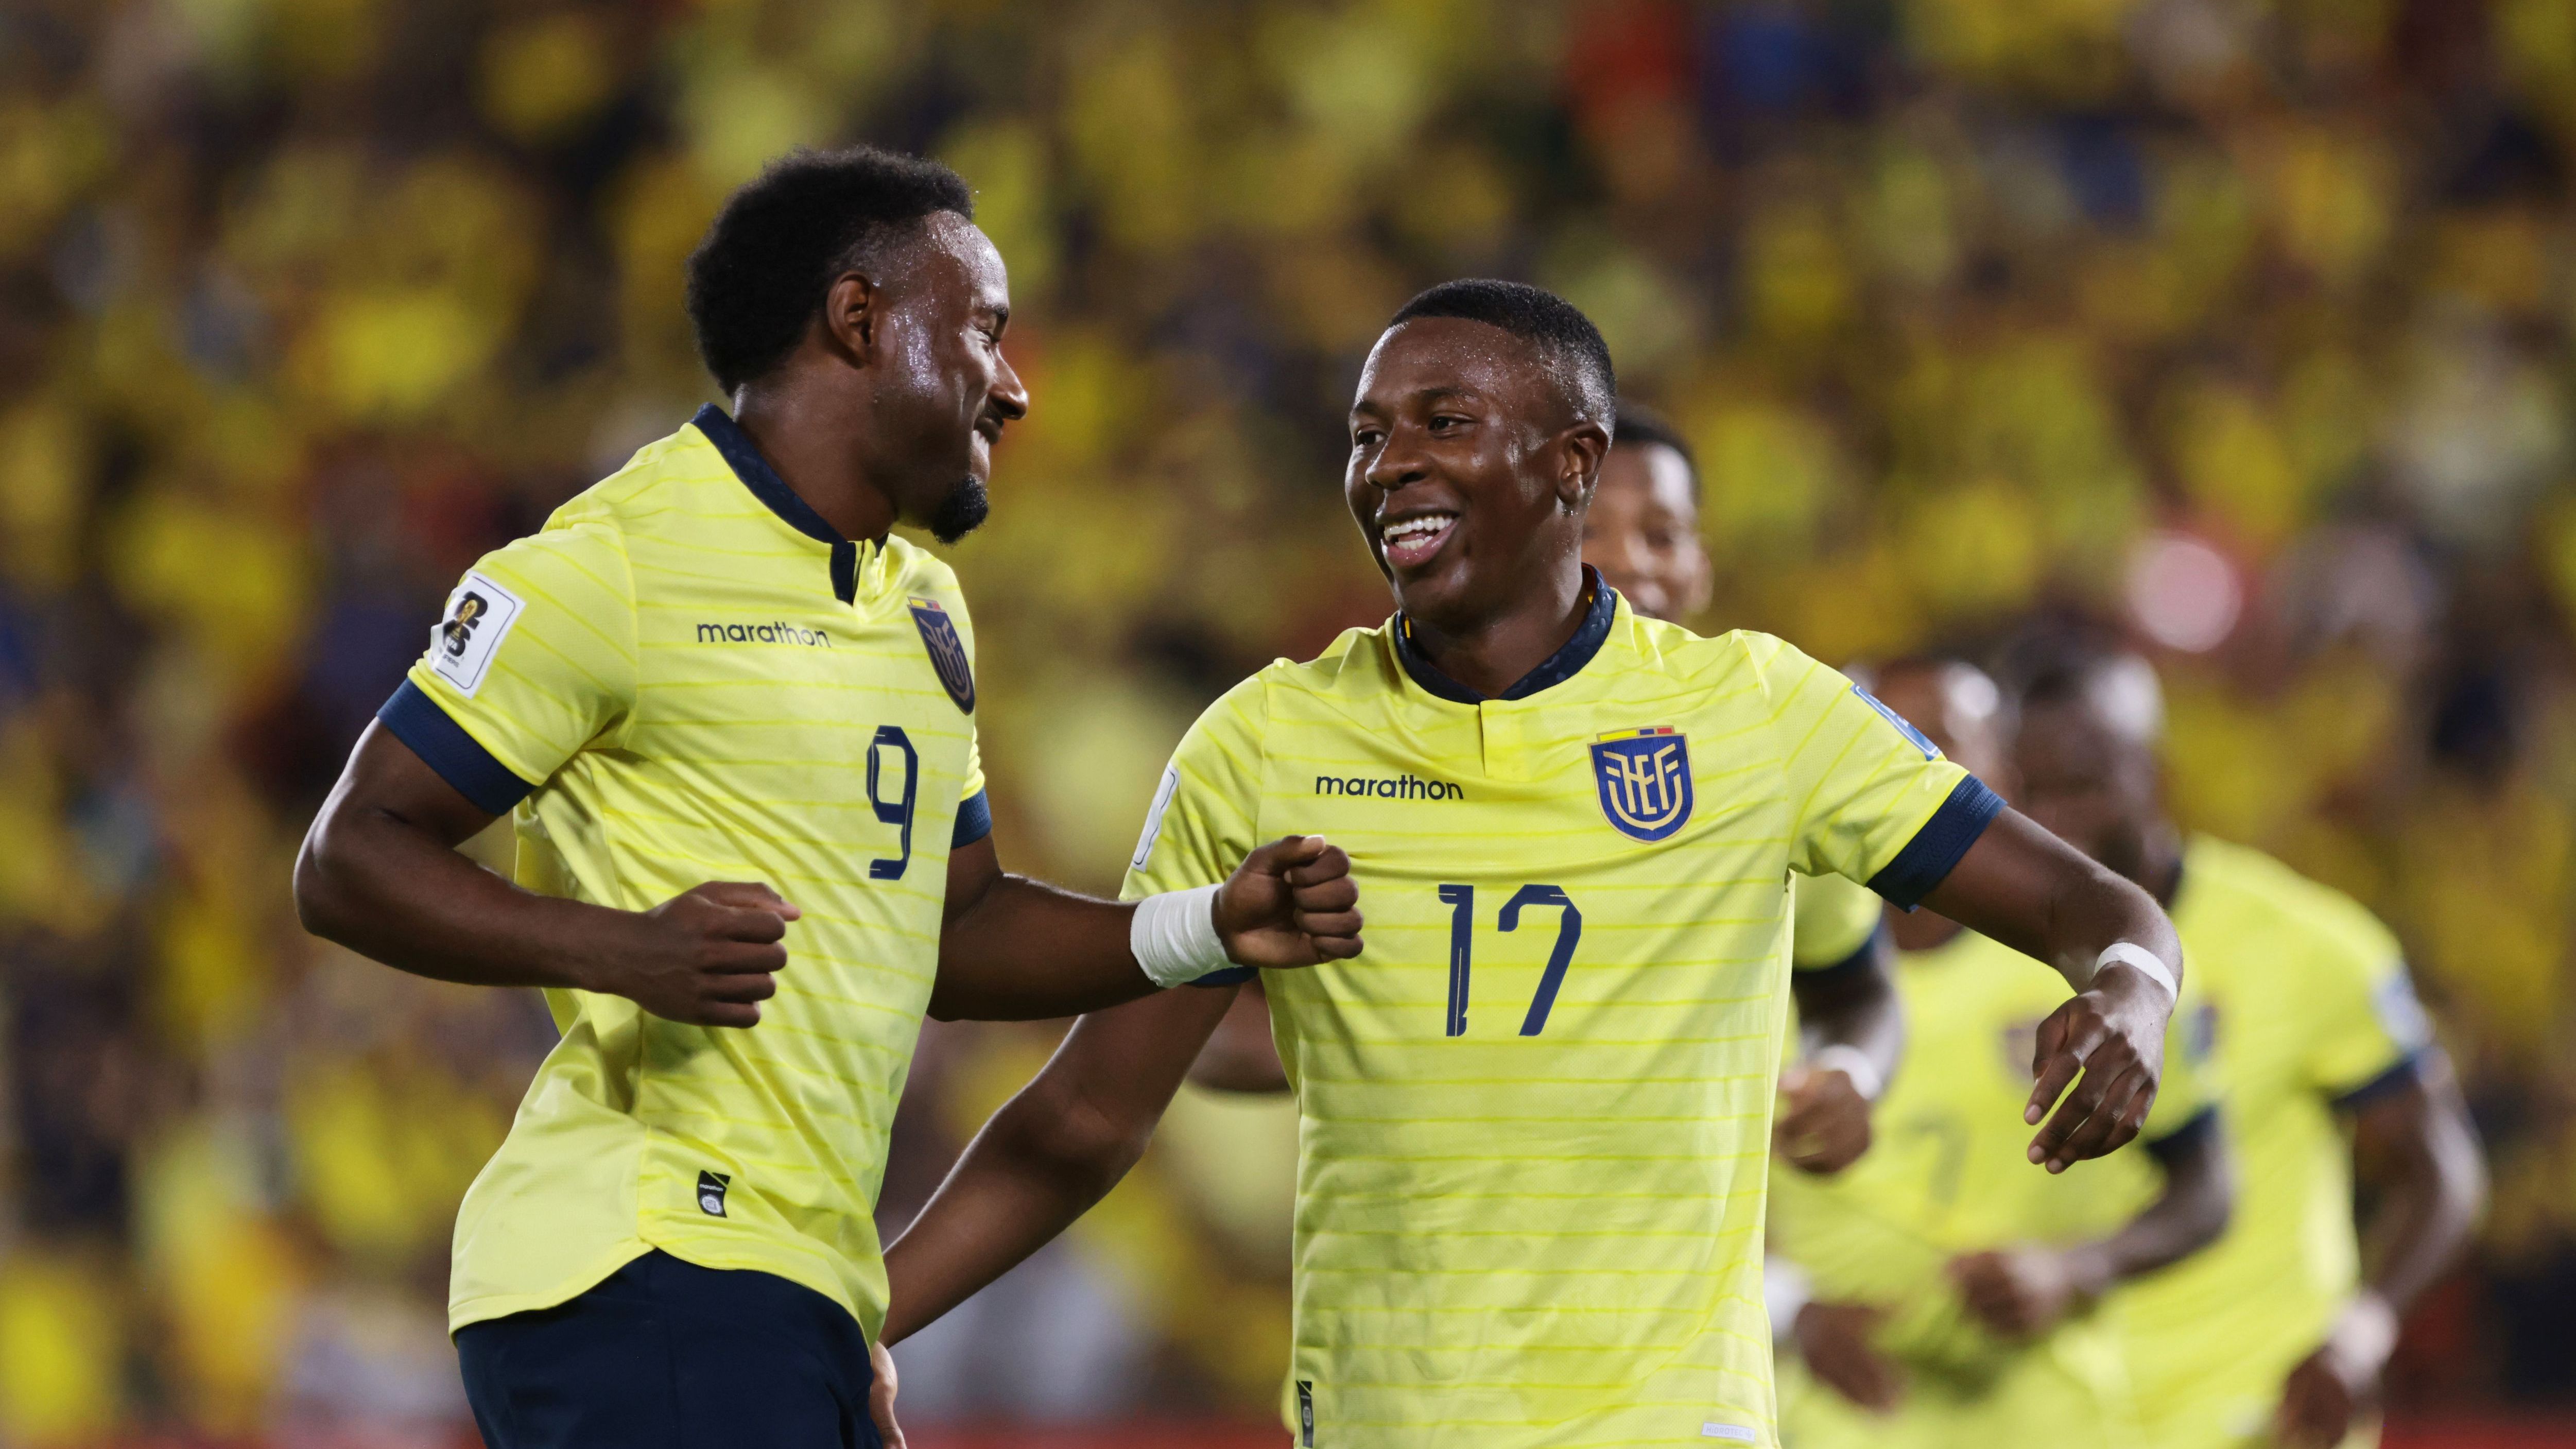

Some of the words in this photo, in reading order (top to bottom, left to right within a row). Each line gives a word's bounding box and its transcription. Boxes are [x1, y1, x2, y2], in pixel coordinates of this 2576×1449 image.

[697, 621, 831, 648] marathon
[1316, 774, 1464, 800] marathon
[867, 726, 918, 881] 9
[1439, 884, 1582, 1037] 17
[699, 1184, 723, 1192] marathon
